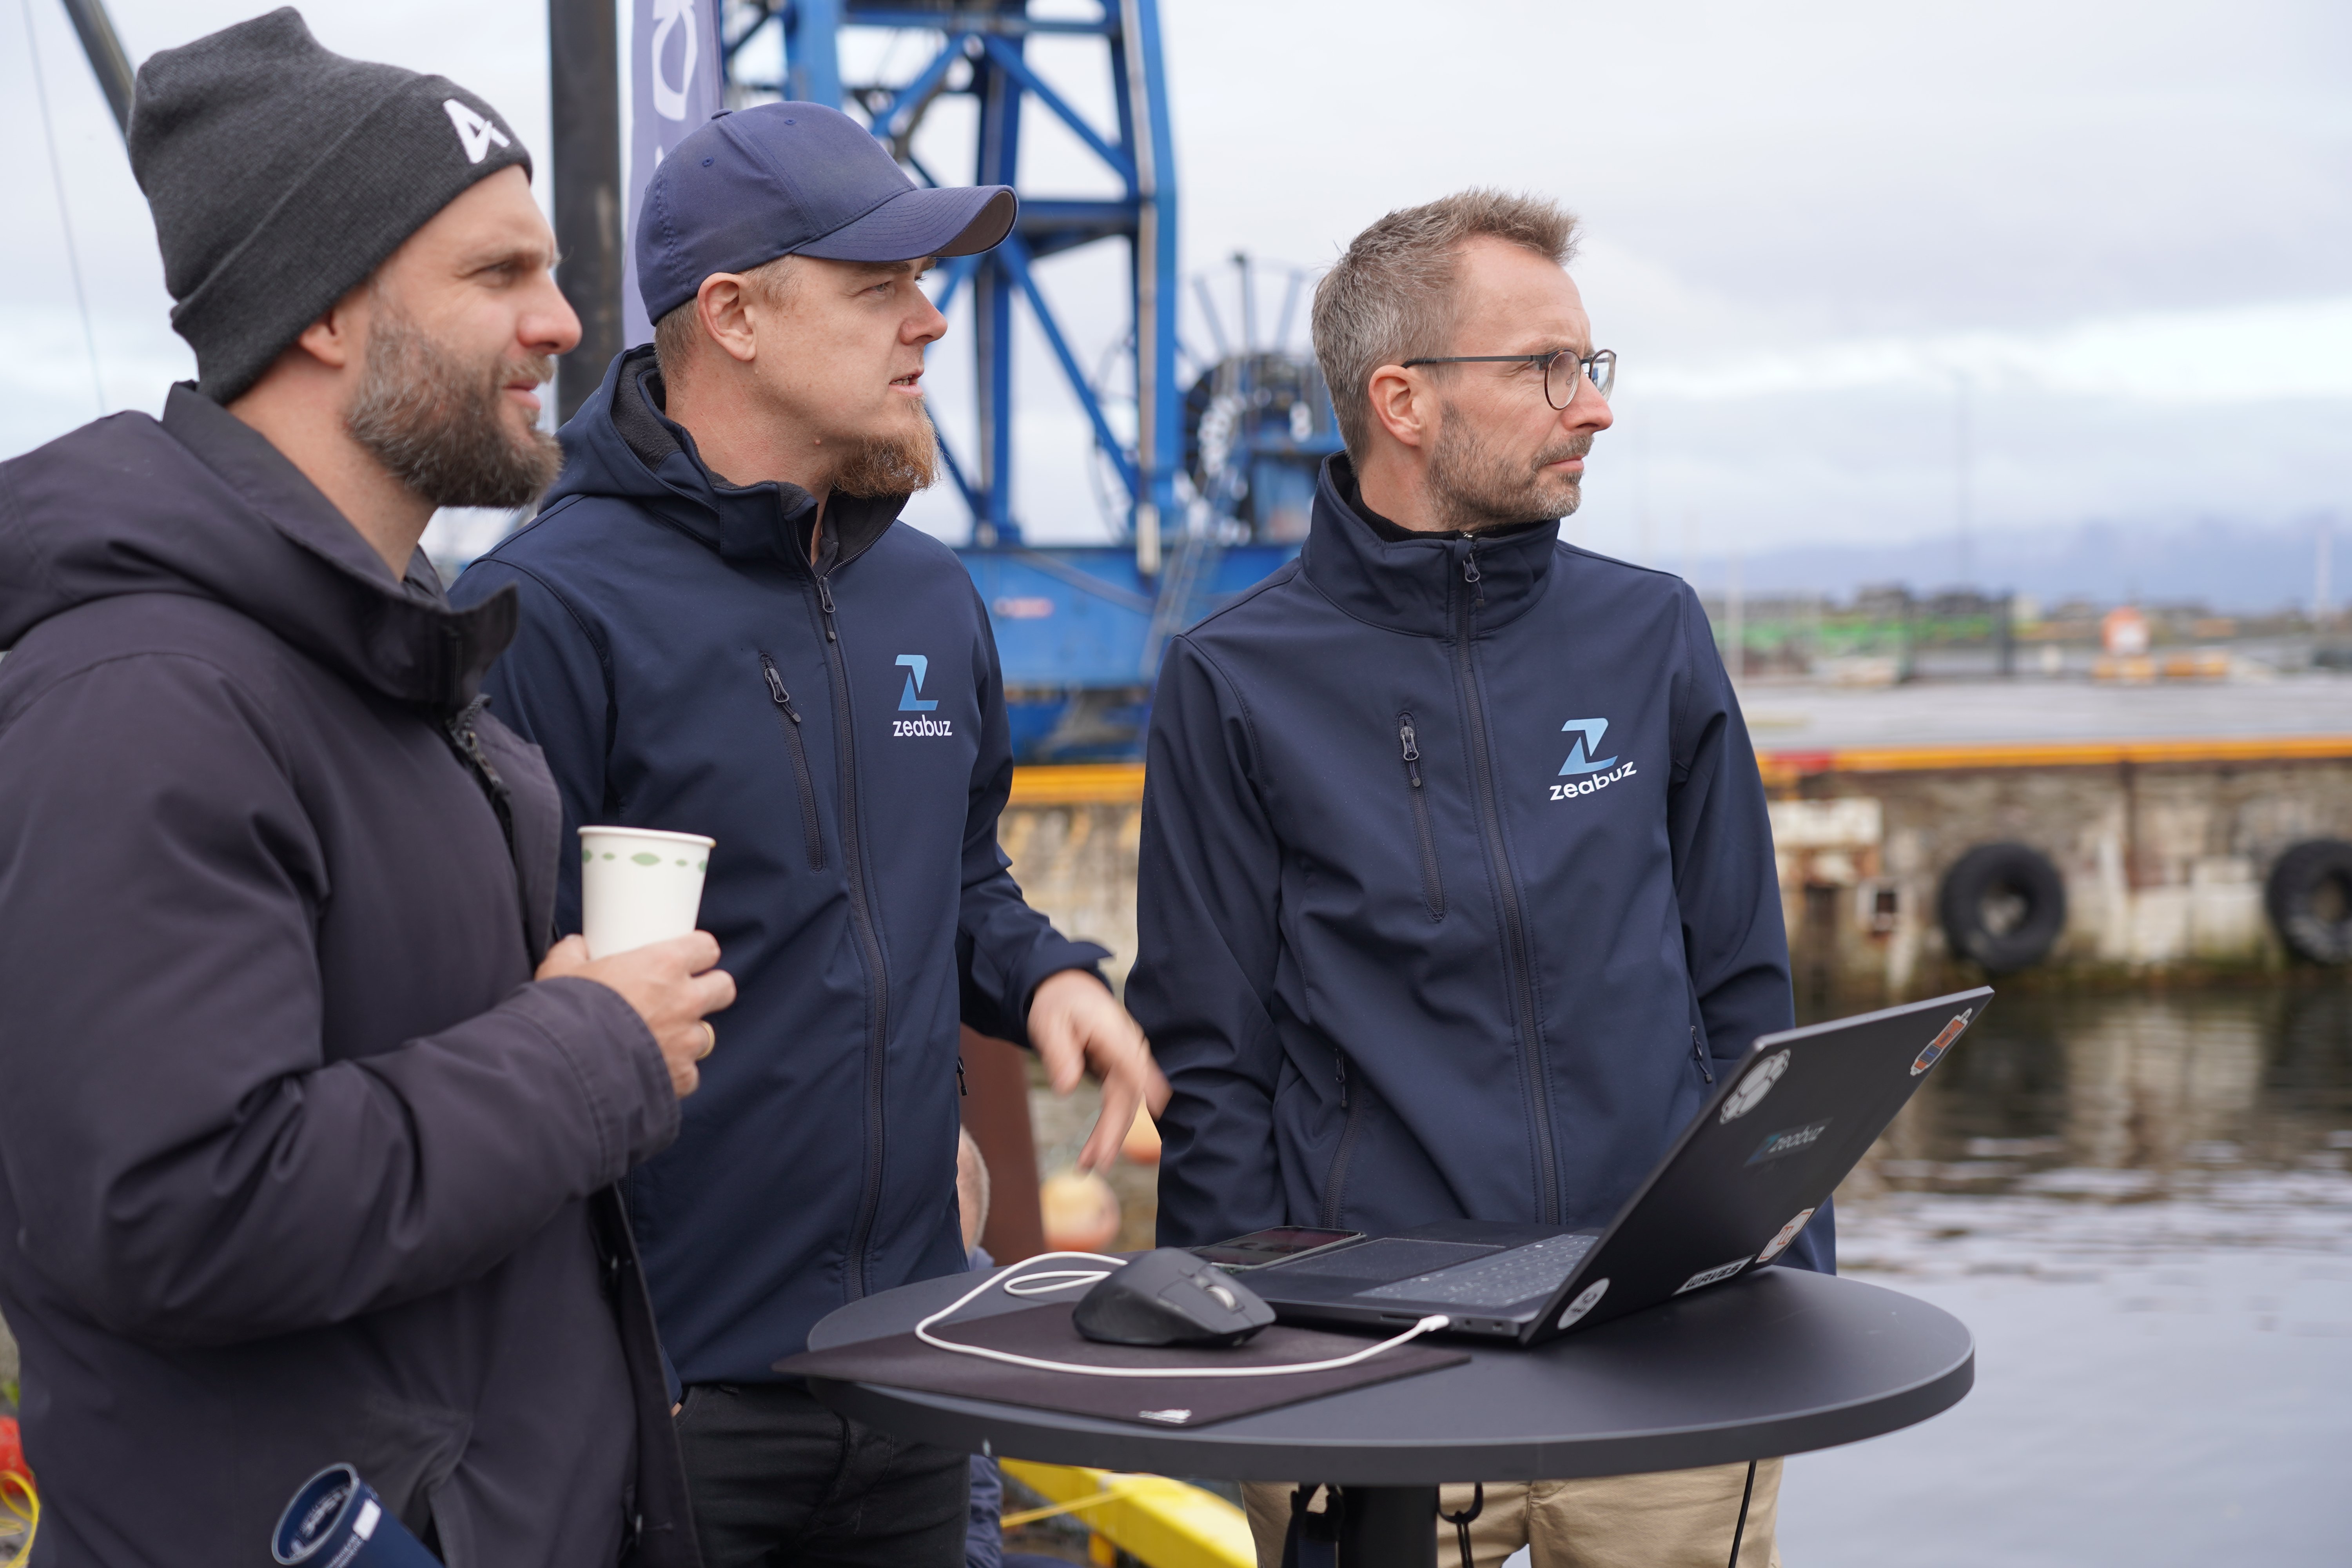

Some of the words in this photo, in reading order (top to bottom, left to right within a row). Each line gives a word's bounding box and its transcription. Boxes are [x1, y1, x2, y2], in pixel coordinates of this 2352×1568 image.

[893, 714, 953, 737] zeabuz
[1549, 761, 1637, 801] zeabuz
[1768, 1125, 1826, 1154] zeabuz
[1686, 1263, 1741, 1288] WAVES
